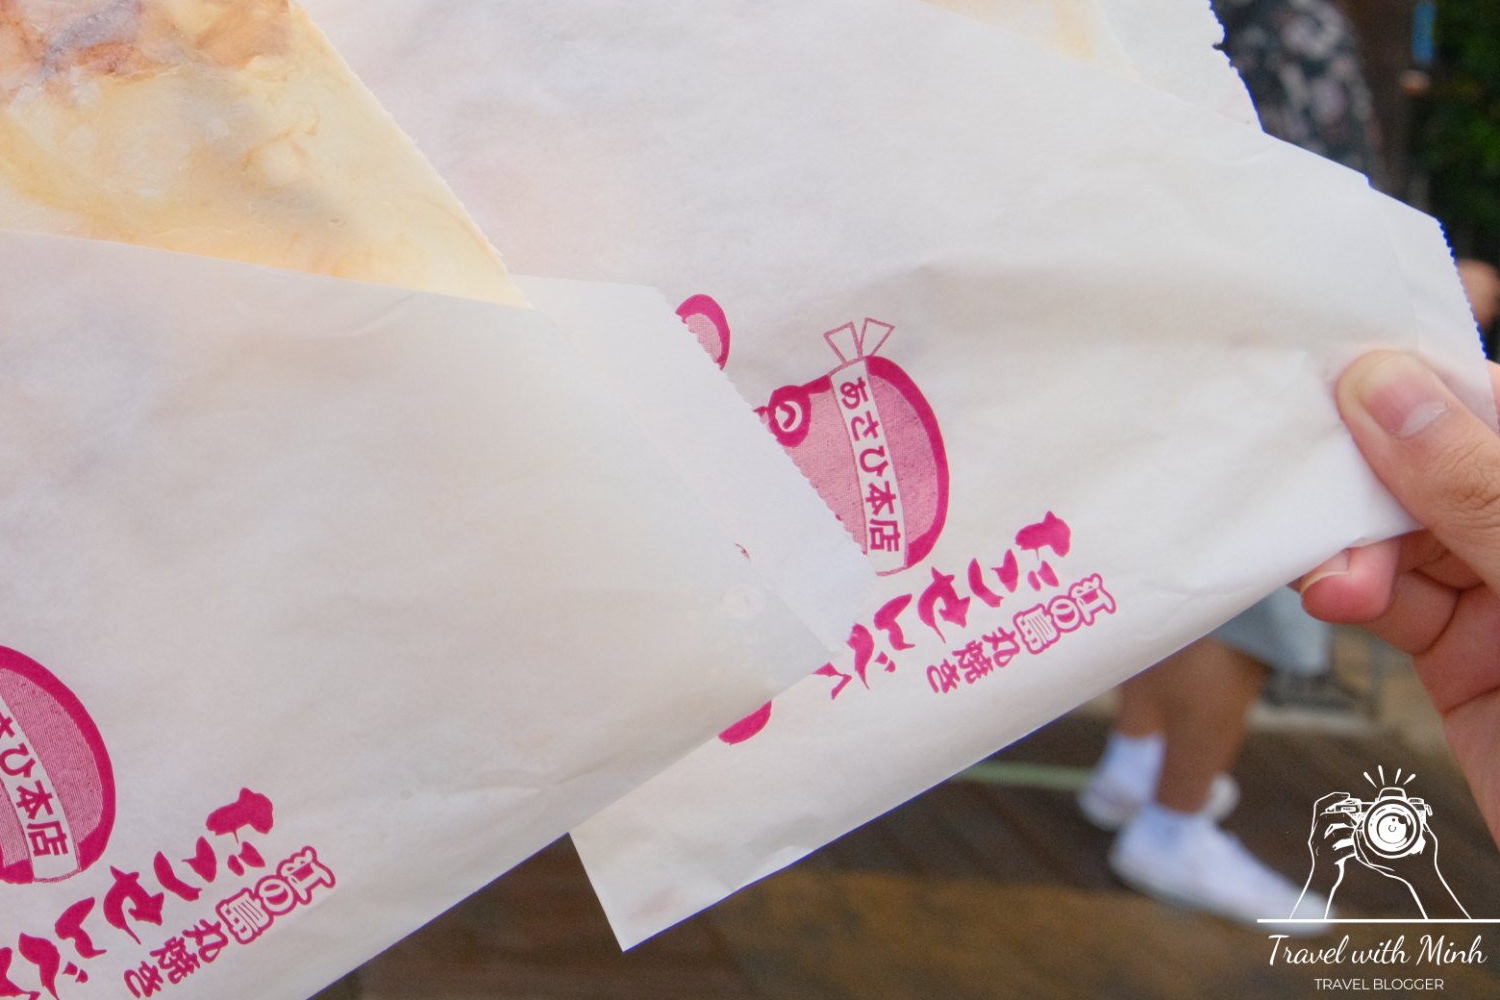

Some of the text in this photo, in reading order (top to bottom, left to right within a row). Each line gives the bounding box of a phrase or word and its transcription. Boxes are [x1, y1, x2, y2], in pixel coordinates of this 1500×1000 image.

[838, 374, 901, 553] あさひ本店
